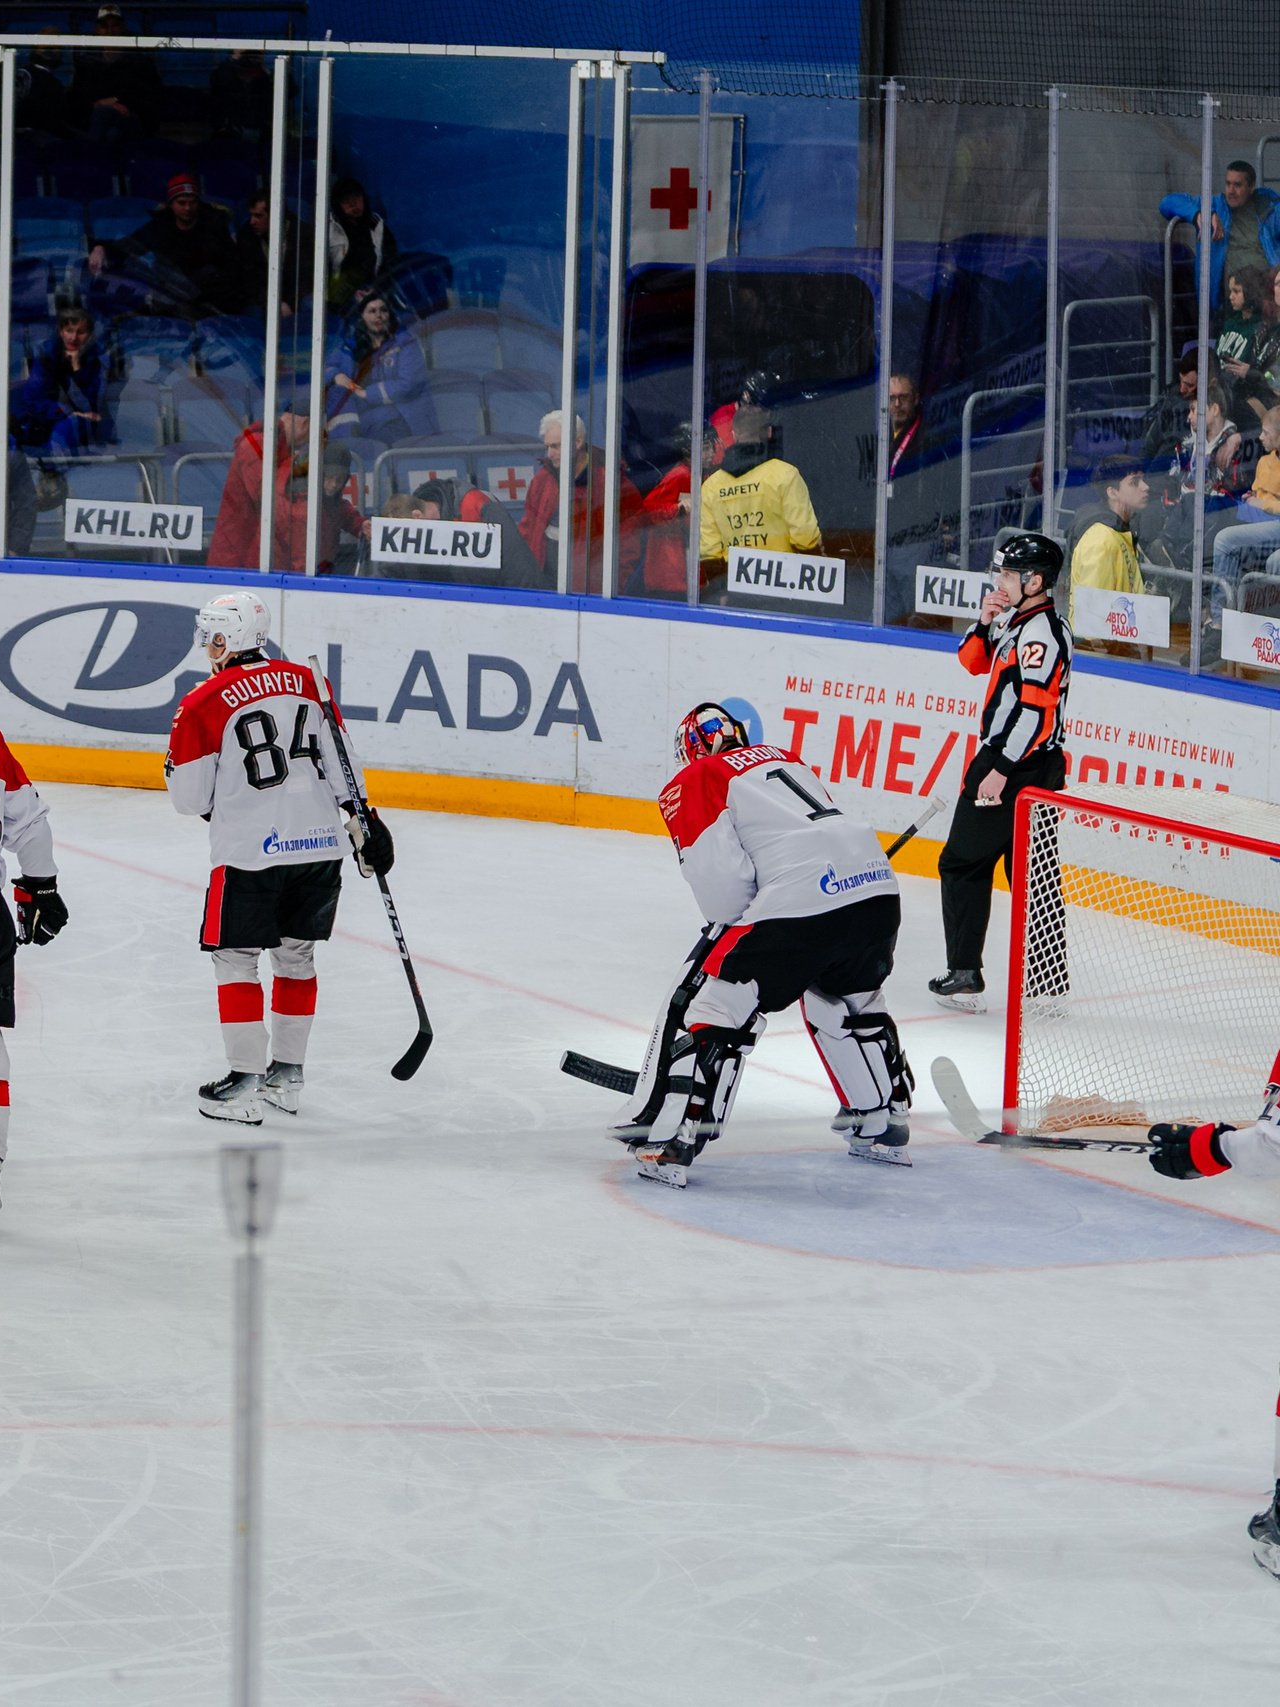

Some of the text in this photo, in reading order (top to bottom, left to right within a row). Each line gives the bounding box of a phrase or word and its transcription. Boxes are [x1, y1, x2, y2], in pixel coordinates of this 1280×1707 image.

[719, 482, 760, 497] SAFETY
[74, 507, 194, 541] KHL.RU
[380, 526, 493, 559] KHL.RU
[735, 556, 838, 593] KHL.RU
[922, 575, 1004, 613] KHL.R
[1105, 612, 1127, 624] АВТО
[1111, 624, 1139, 638] РАДИО
[255, 632, 266, 646] 84
[1251, 636, 1273, 650] АВТО
[221, 671, 304, 709] GULYAYEV
[328, 643, 603, 743] LADA
[785, 675, 978, 718] МЫ ВСЕГДА НА СВЯЗИ
[234, 704, 327, 791] 84
[1064, 717, 1235, 768] HOCKEY #UNITEDWEWIN
[765, 767, 844, 822] 1
[381, 892, 410, 961] CCM
